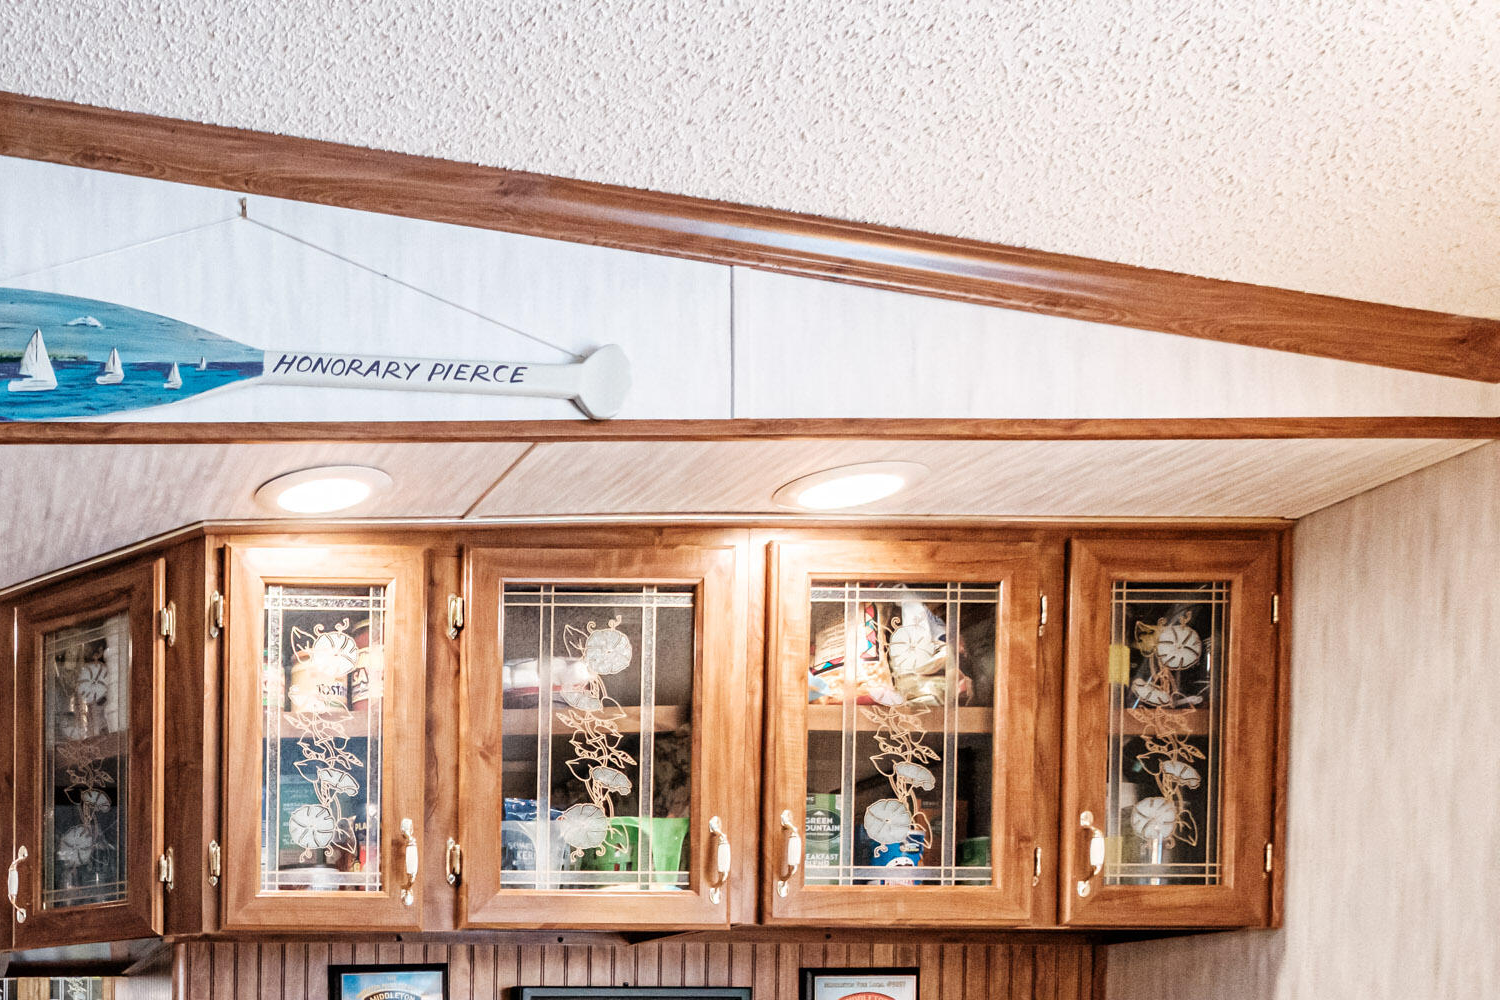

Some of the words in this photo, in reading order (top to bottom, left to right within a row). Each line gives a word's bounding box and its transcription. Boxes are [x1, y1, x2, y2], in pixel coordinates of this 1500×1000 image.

[272, 354, 421, 381] HONORARY
[427, 363, 529, 384] PIERCE
[805, 824, 840, 832] OUNTAIN
[805, 853, 839, 861] EAKFAST
